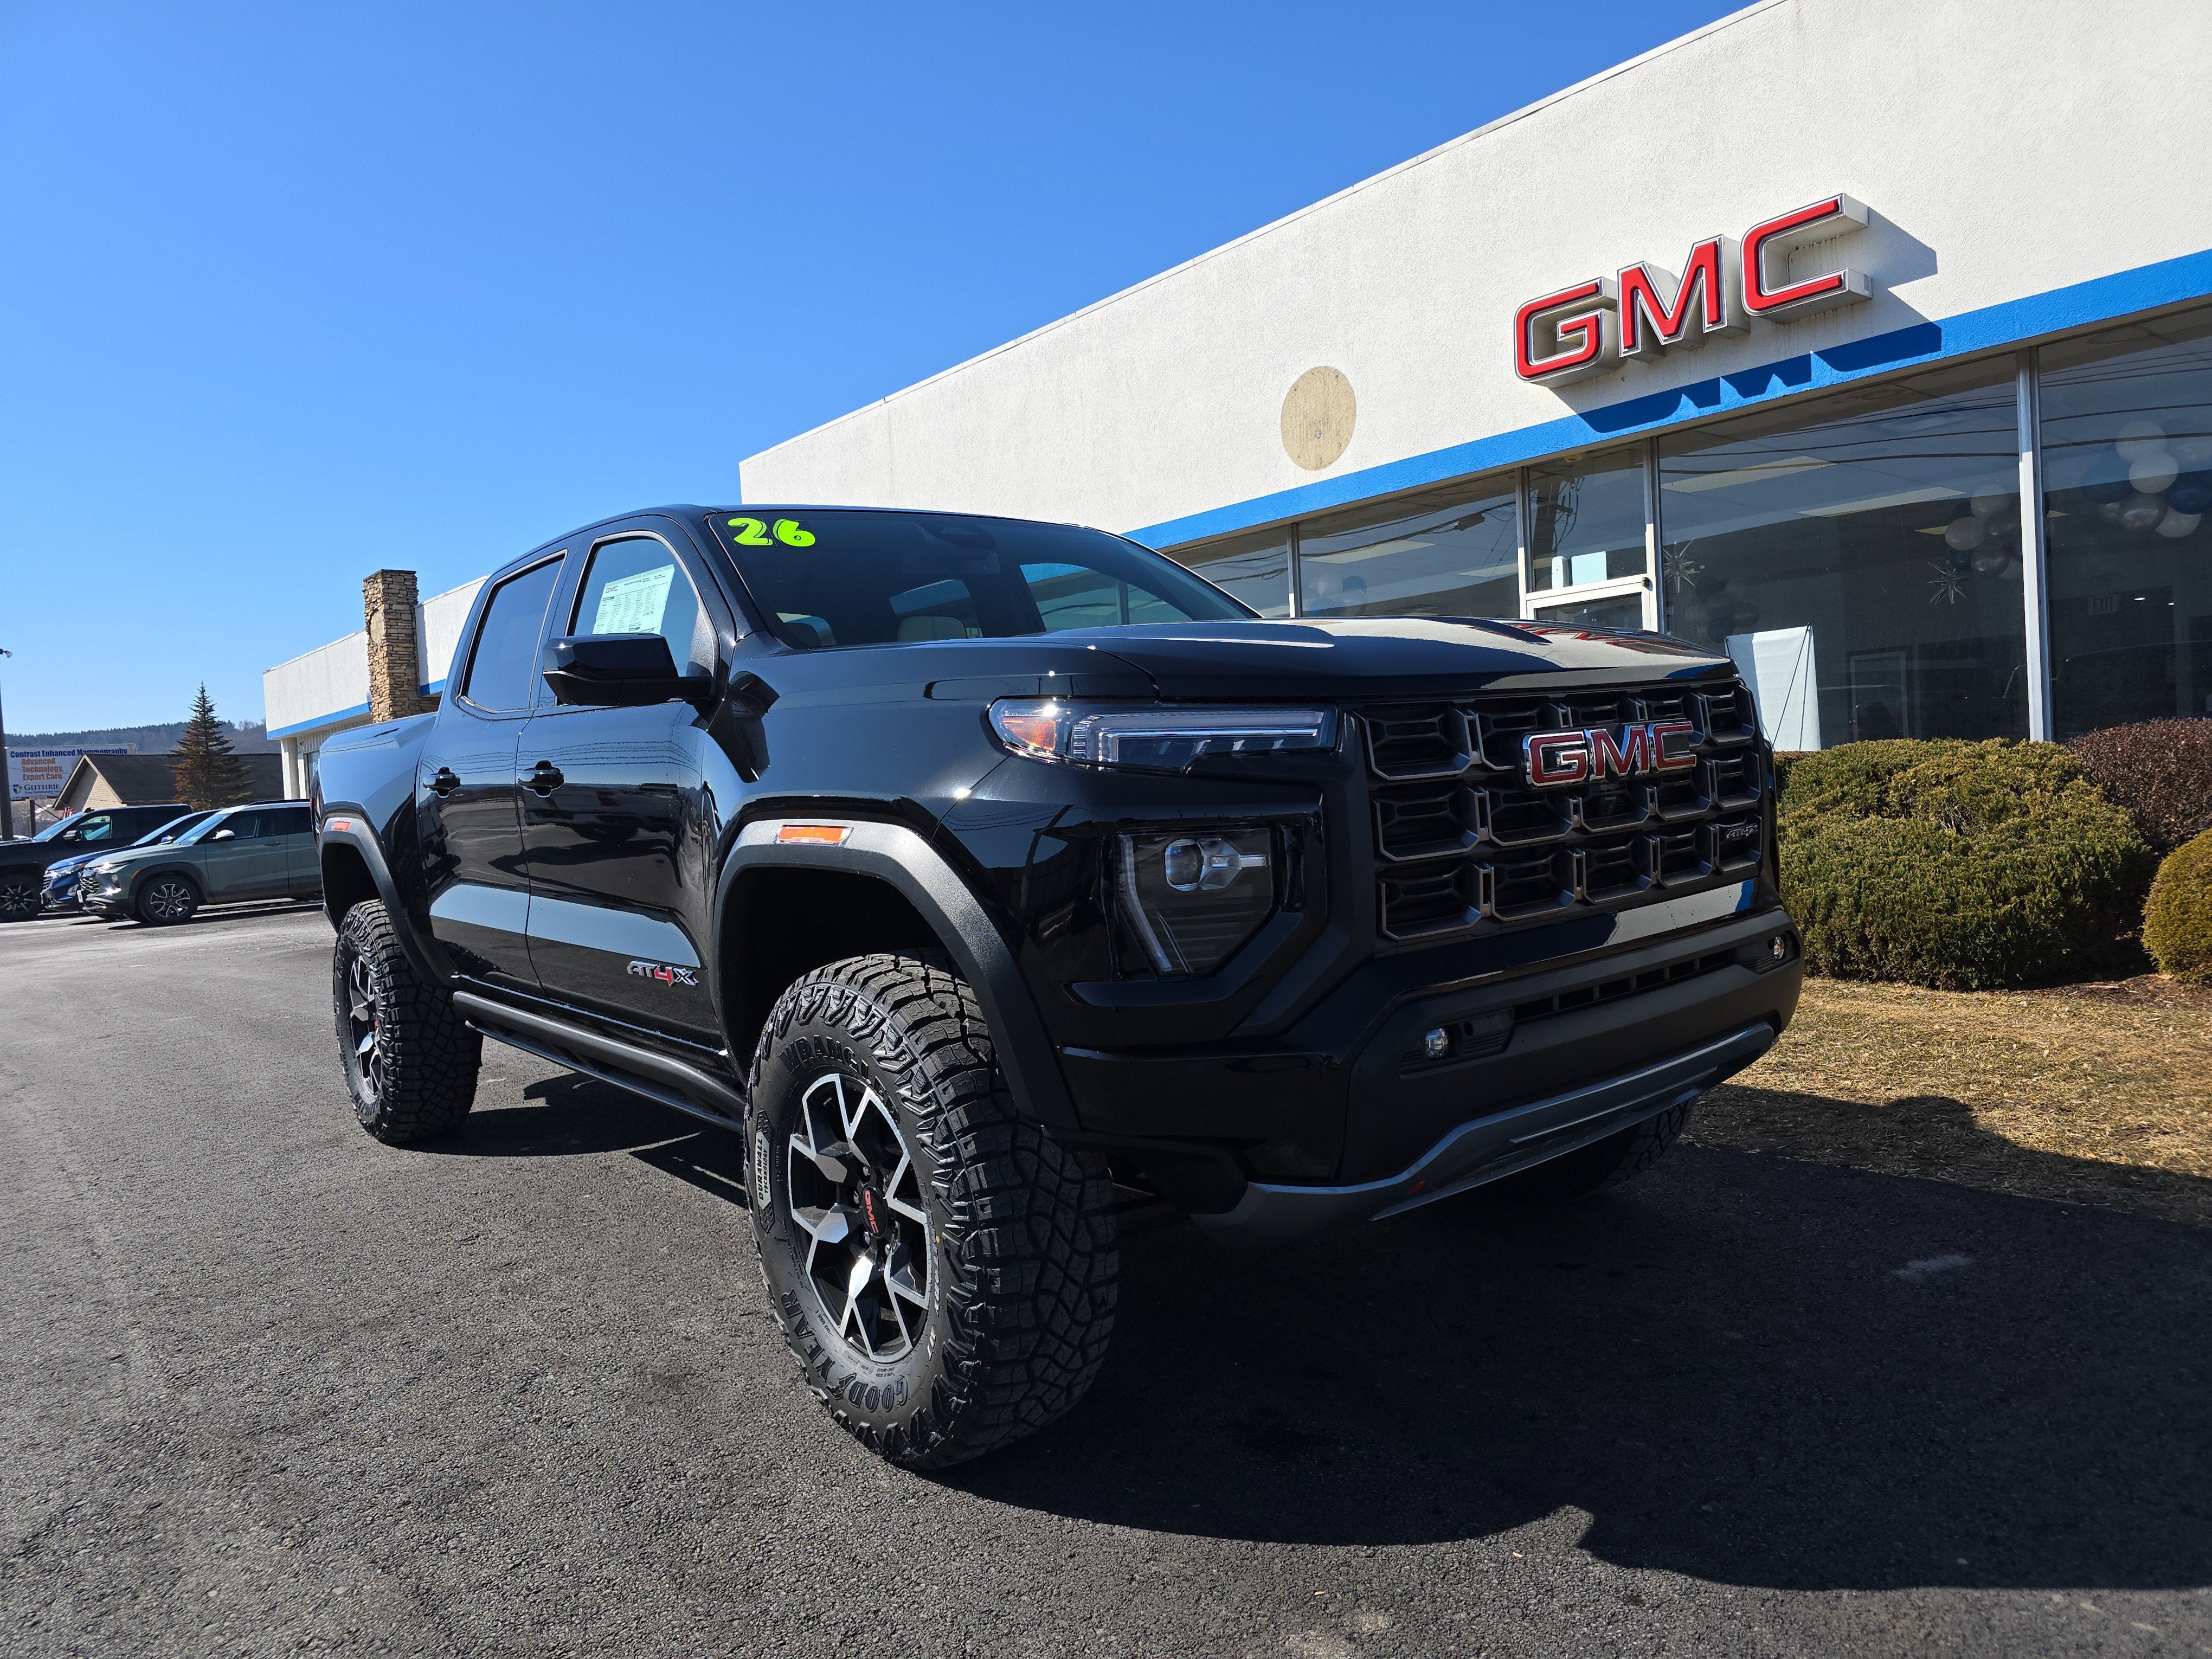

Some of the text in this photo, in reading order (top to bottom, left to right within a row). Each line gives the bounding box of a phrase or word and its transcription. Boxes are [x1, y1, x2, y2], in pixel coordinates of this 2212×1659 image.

[1514, 192, 1849, 383] GMC
[728, 518, 816, 547] 26
[2092, 597, 2114, 613] EXIT
[1522, 721, 1697, 787] GMC
[627, 961, 700, 987] AT4X
[780, 1034, 901, 1127] WRANGLER
[865, 1189, 878, 1233] GMC
[781, 1289, 908, 1413] GOODYEAR
